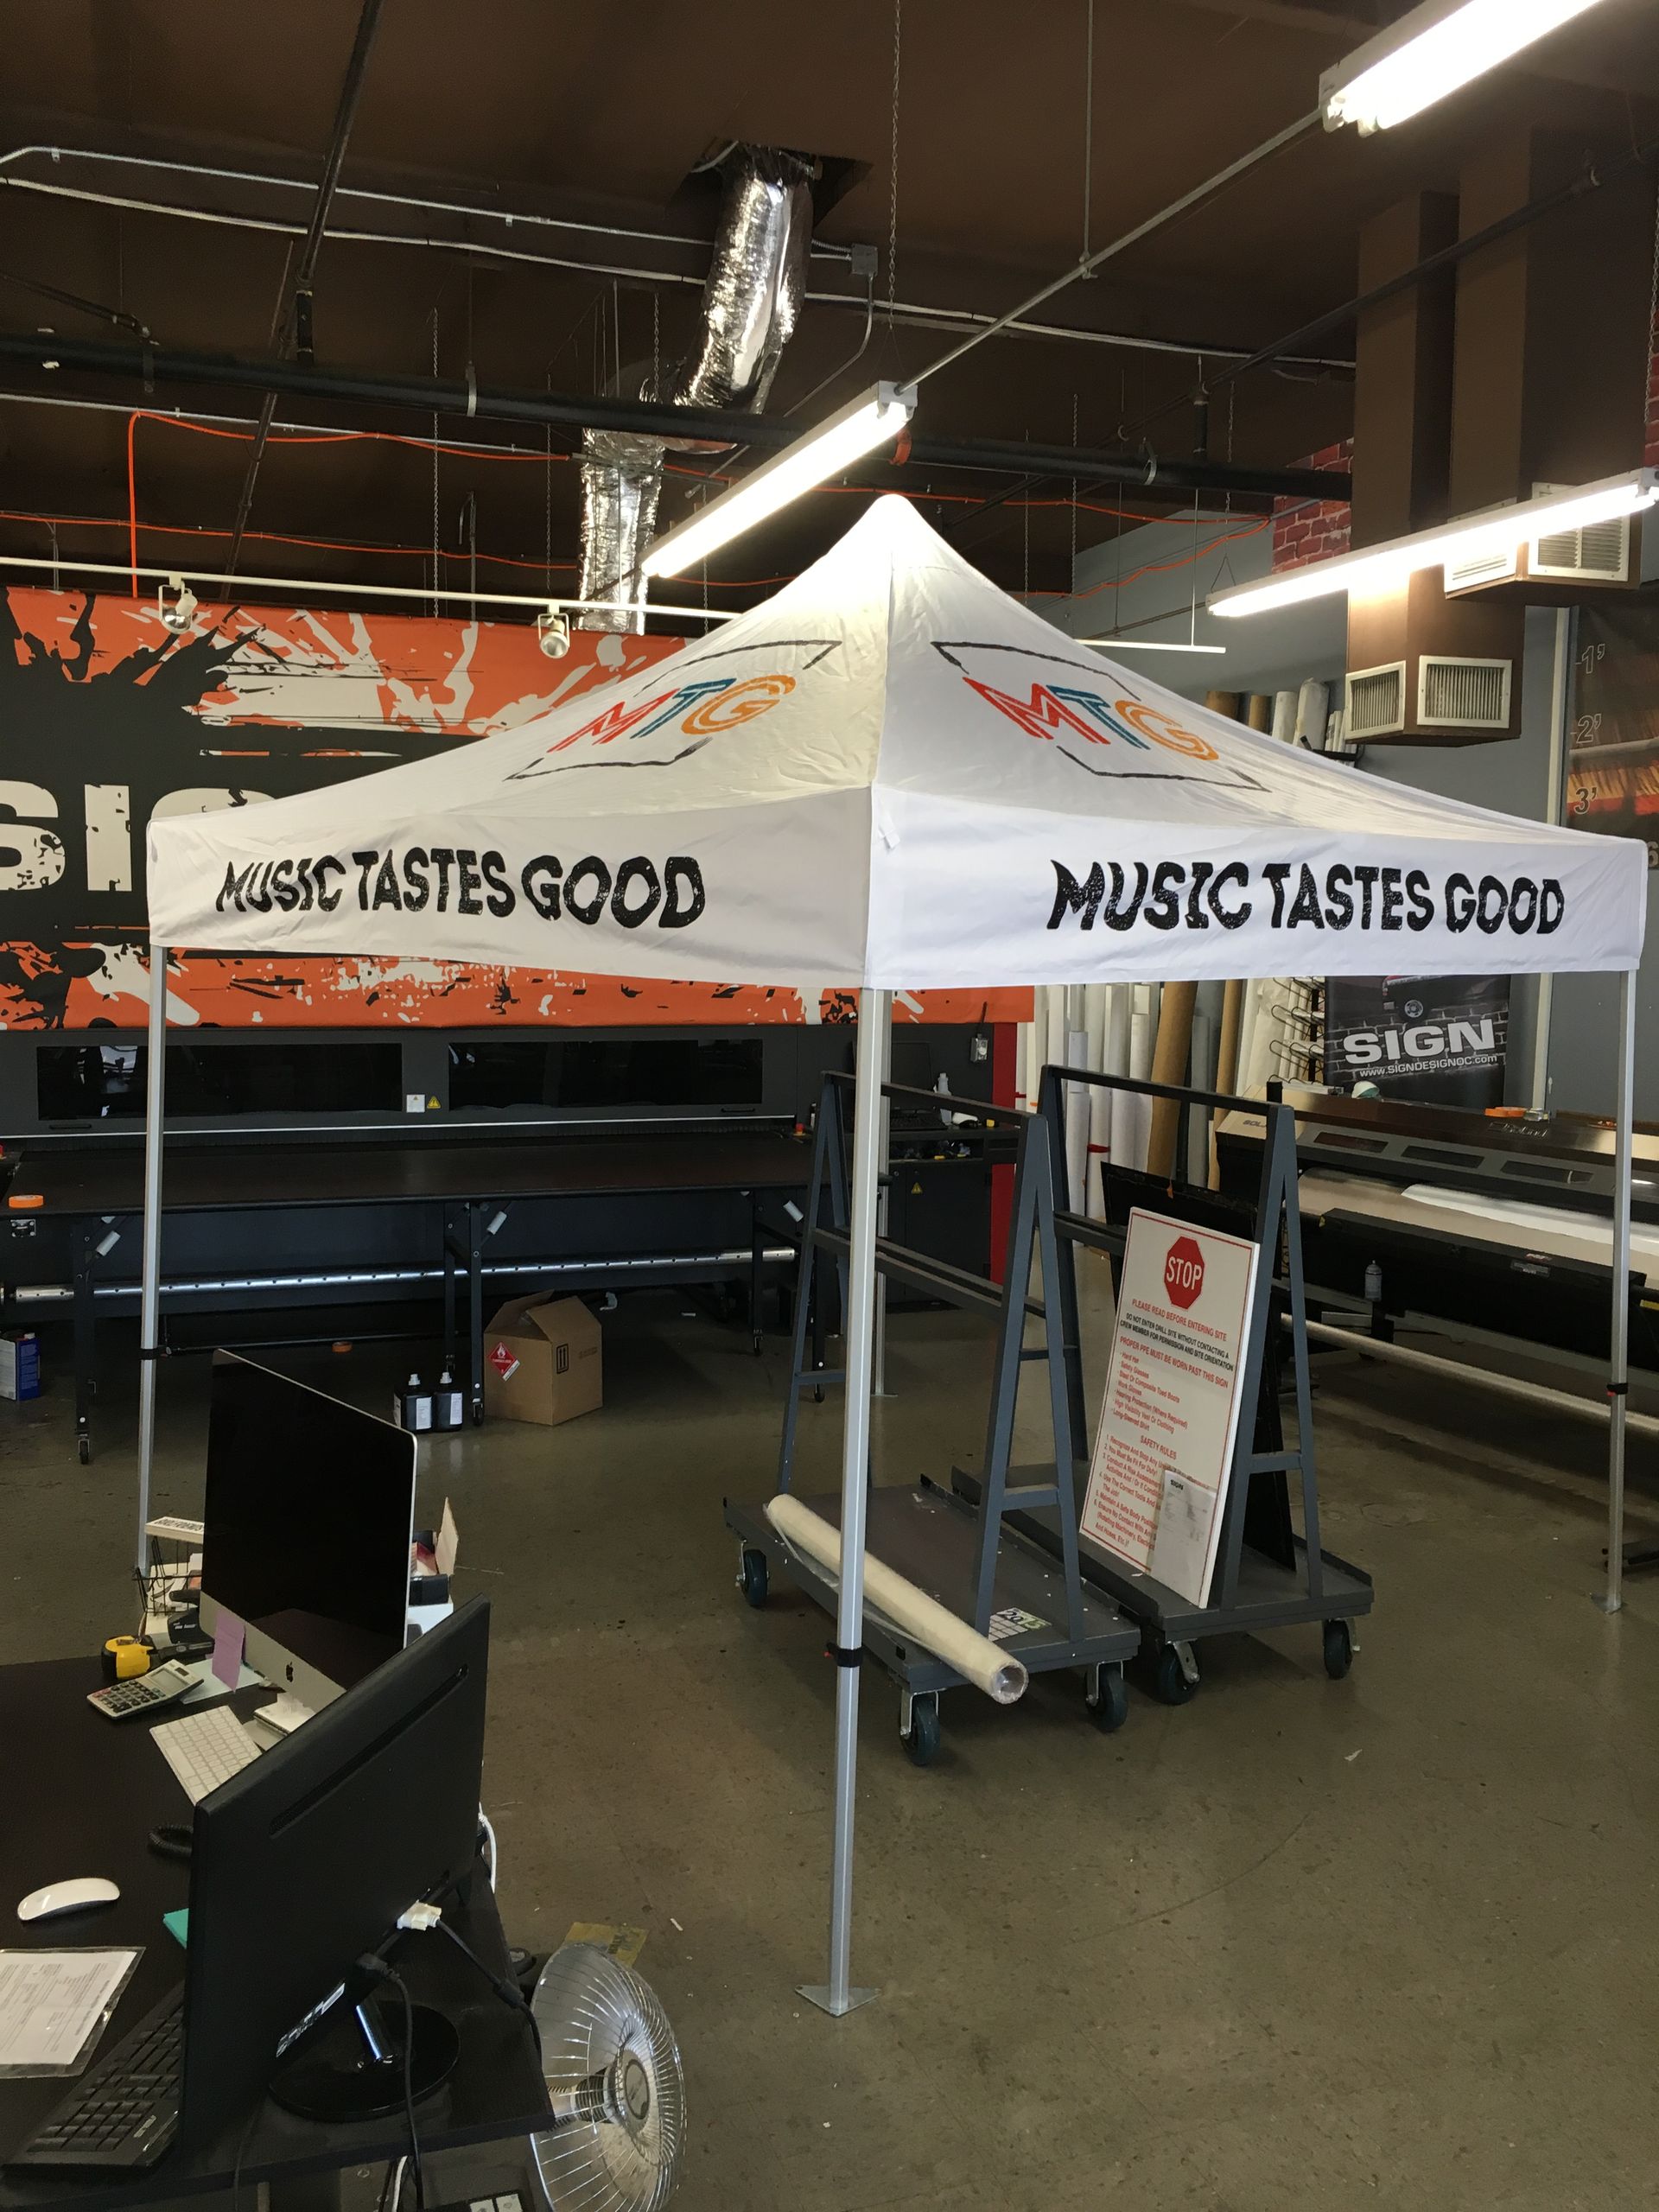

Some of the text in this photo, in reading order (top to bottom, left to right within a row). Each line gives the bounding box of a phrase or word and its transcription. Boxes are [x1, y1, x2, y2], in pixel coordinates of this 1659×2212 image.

[547, 675, 796, 753] MTG
[963, 677, 1219, 761] MTG
[216, 848, 705, 928] MUSIC TASTES GOOD
[1047, 859, 1565, 934] MUSIC TASTES GOOD
[1343, 1019, 1495, 1065] SIGN
[1359, 1055, 1497, 1077] www.SIGNDESIGNOC.com
[1166, 1255, 1202, 1290] STOP
[1132, 1299, 1227, 1340] PLEASE READ BEFORE ENTERING SITE
[1141, 1319, 1154, 1329] ENTER
[1155, 1325, 1166, 1333] DRILL
[1167, 1329, 1176, 1338] SITE
[1177, 1333, 1197, 1345] WITHOUT
[1197, 1340, 1224, 1357] CONTACTING
[1120, 1319, 1233, 1370] CREW MEMBER FOR PERMISSION AND SITE ORIENTATION
[1120, 1336, 1228, 1388] PROPER PPE MUST BE WORN PAST THIS SIGN
[1140, 1435, 1177, 1459] SAFETY RULES
